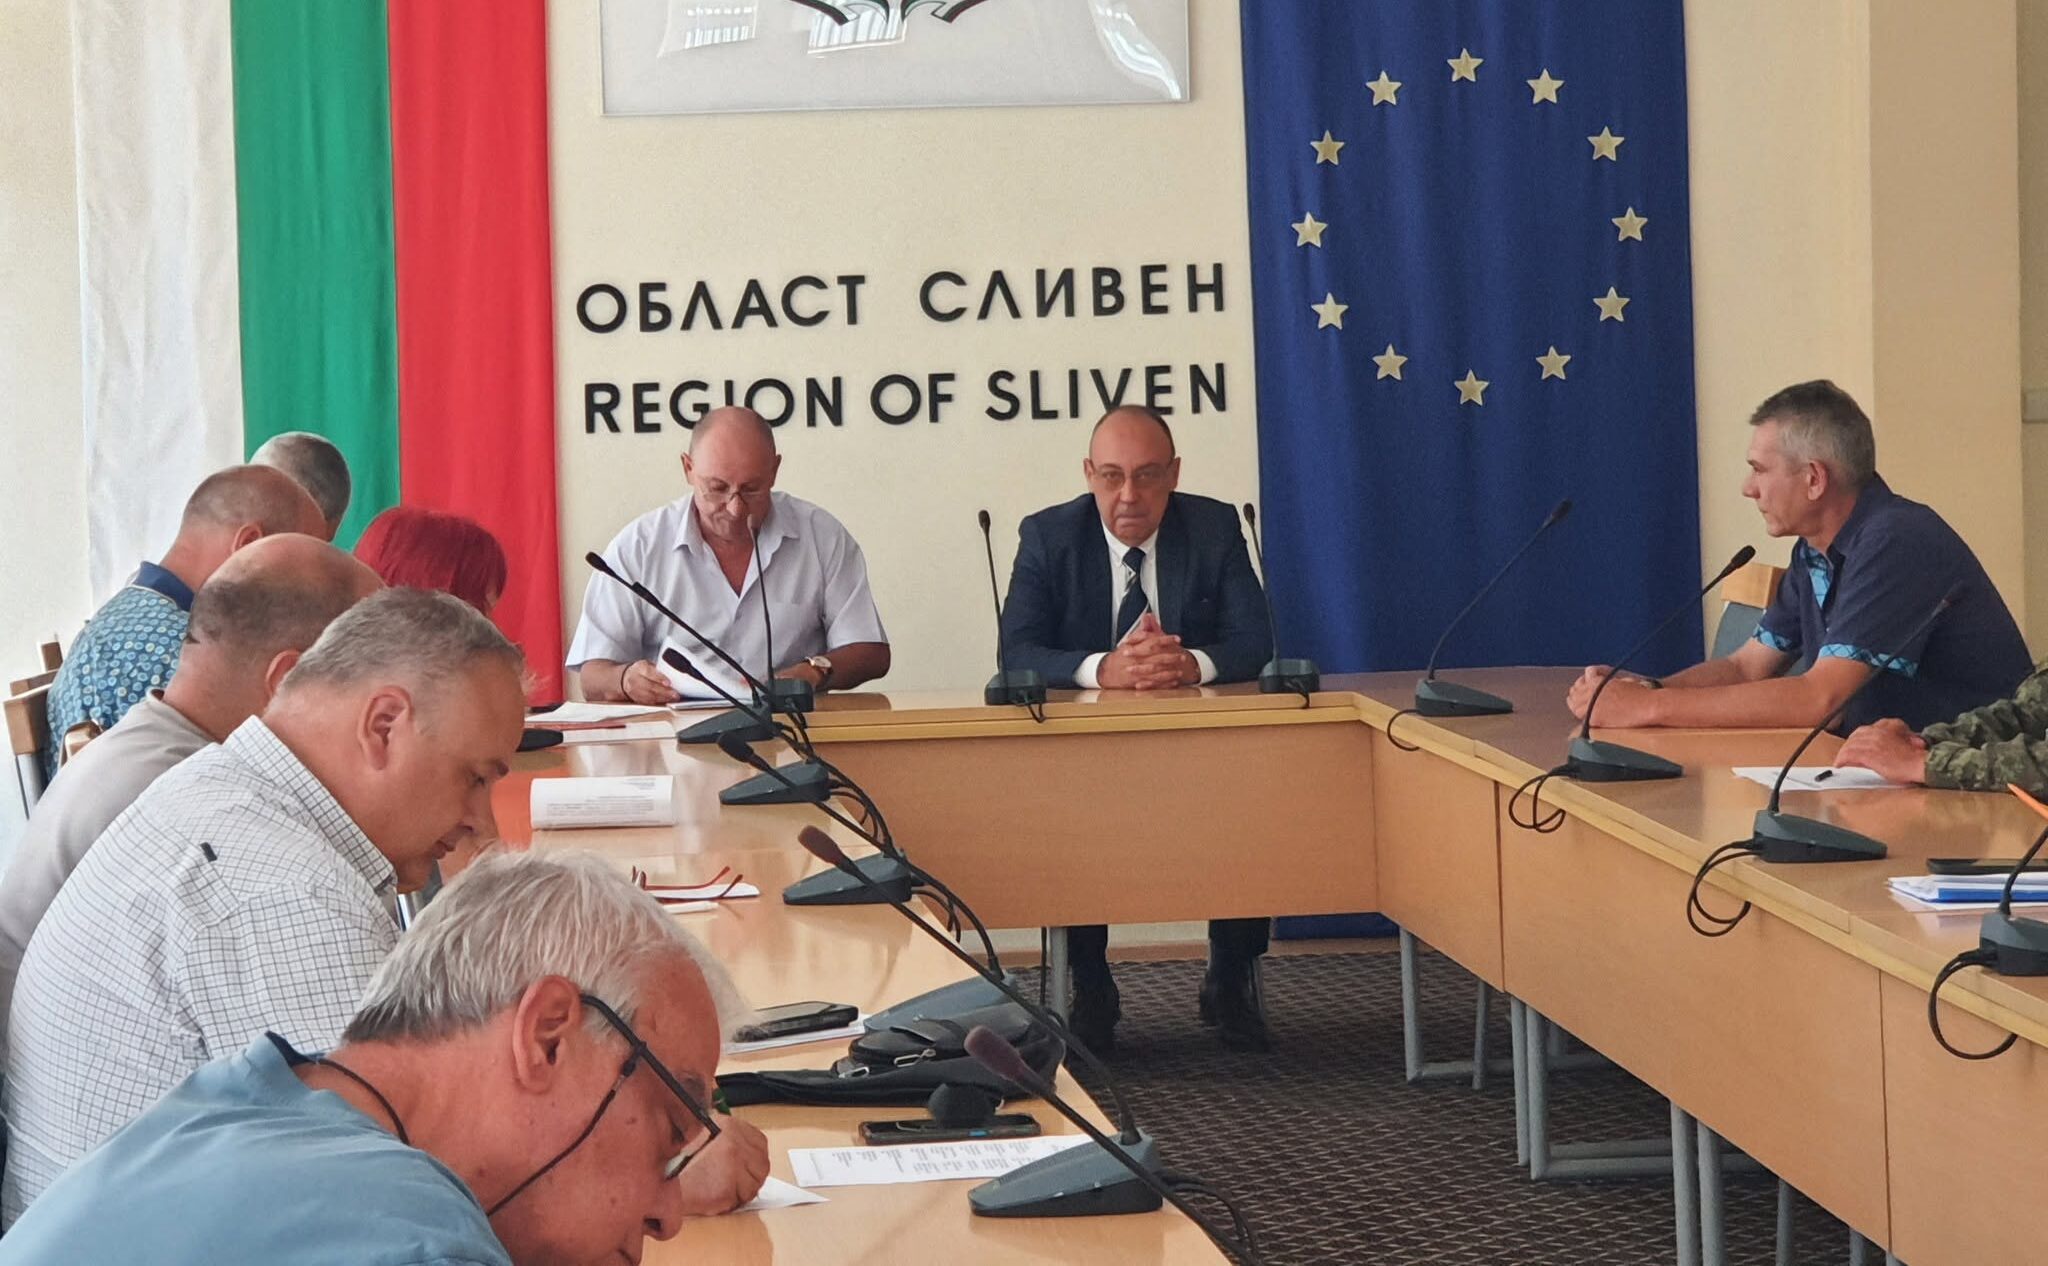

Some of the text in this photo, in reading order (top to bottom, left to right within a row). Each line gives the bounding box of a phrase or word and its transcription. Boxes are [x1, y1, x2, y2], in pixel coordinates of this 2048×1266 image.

[576, 262, 1226, 334] ОБЛАСТ СЛИВЕН
[584, 362, 1228, 434] REGION OF SLIVEN
